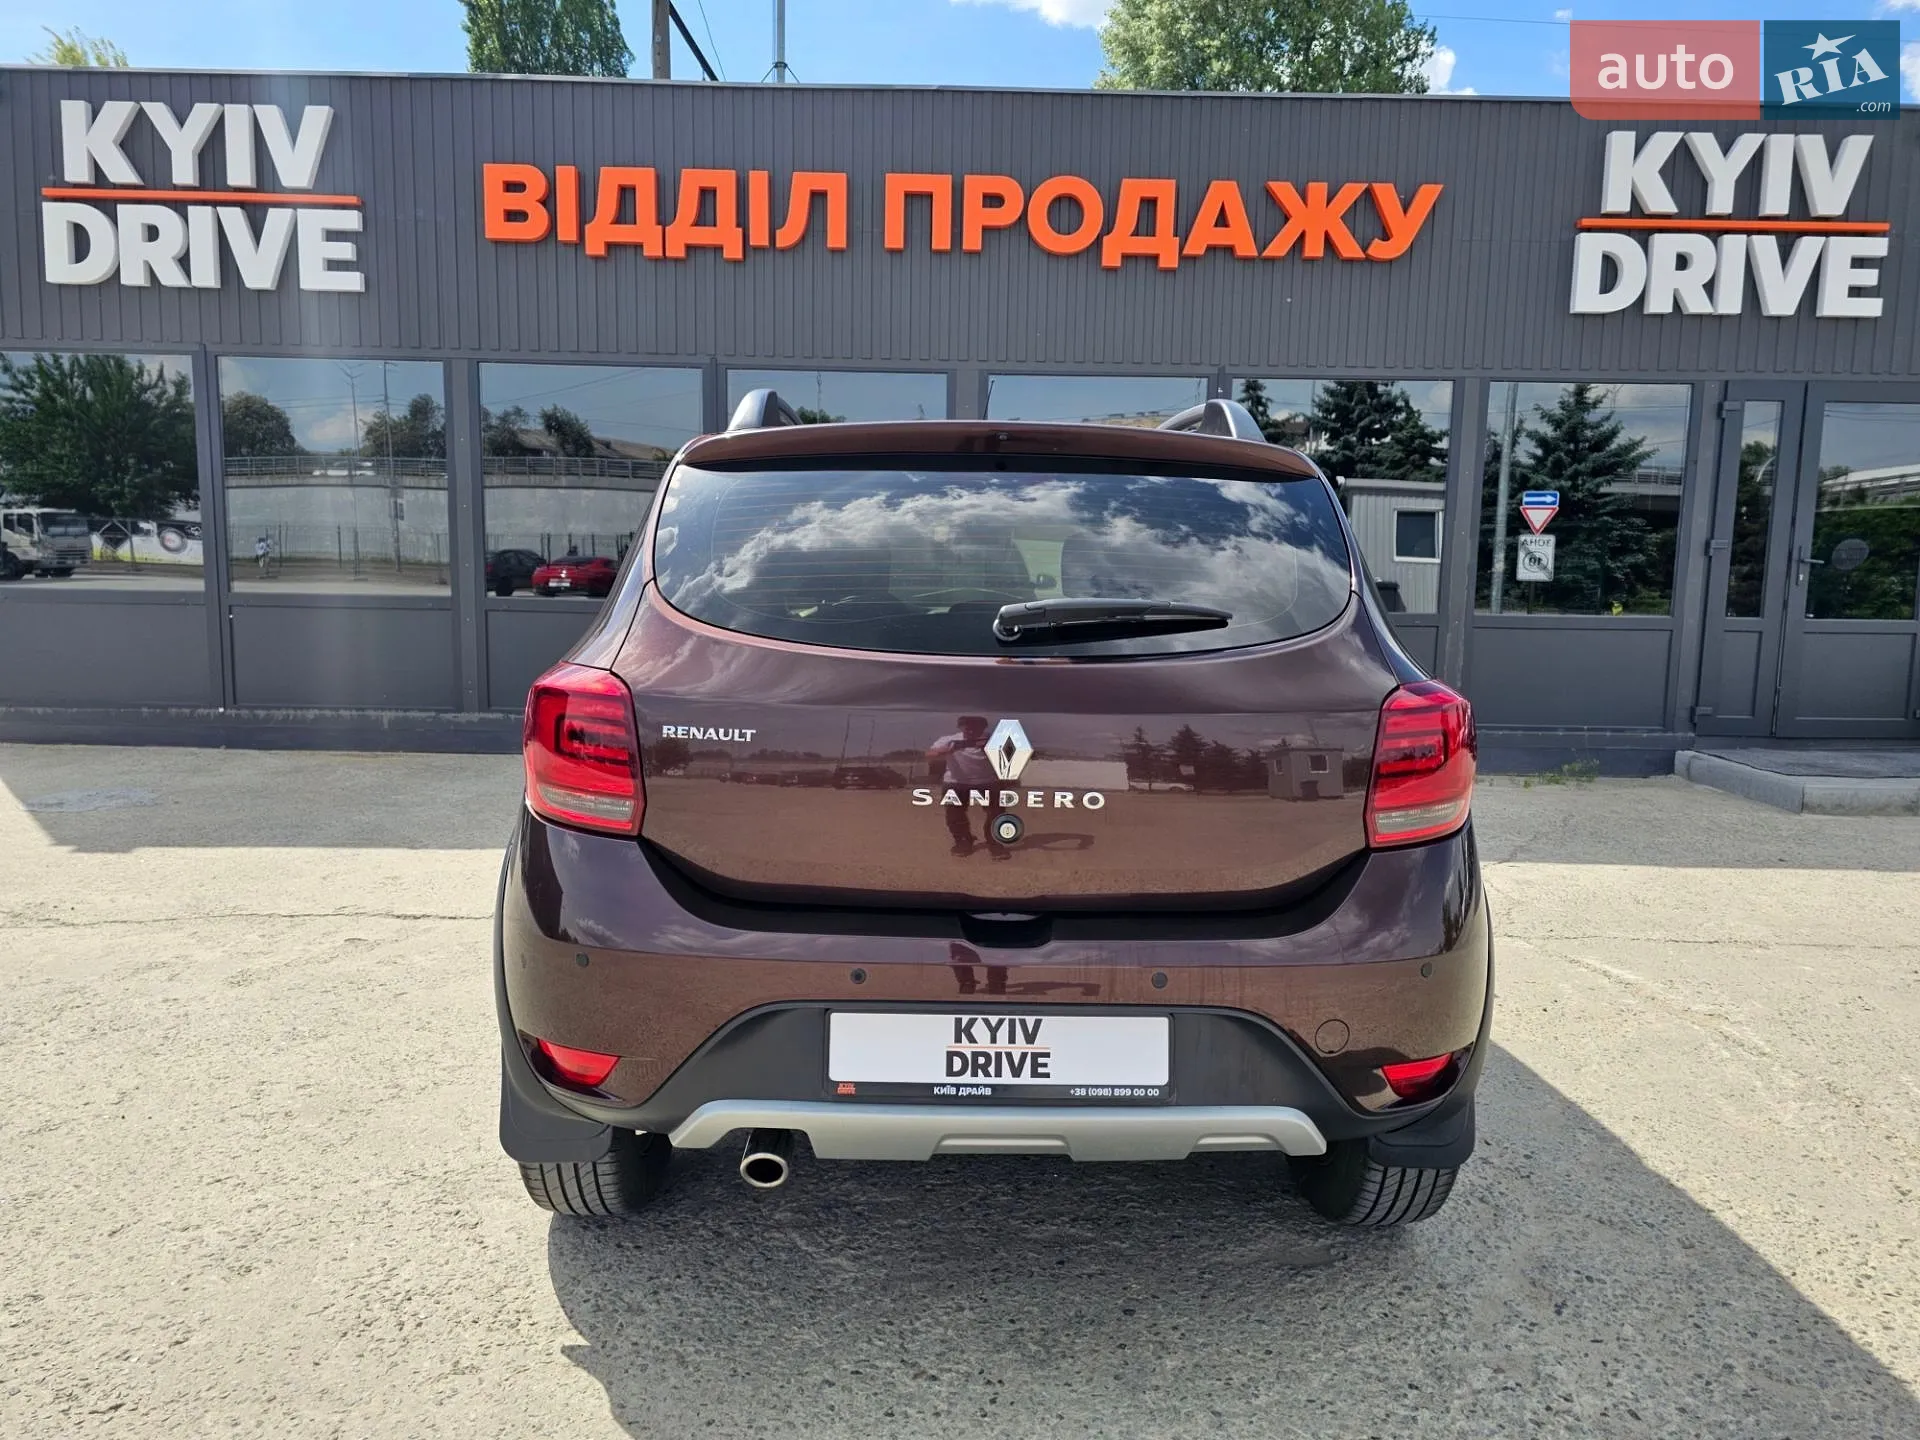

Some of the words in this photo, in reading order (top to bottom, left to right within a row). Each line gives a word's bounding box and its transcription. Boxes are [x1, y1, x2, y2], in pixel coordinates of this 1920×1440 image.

[60, 100, 334, 190] KYIV
[1600, 130, 1874, 217] KYIV
[483, 163, 848, 261] ВІДДІЛ
[884, 172, 1444, 271] ПРОДАЖУ
[42, 202, 365, 293] DRIVE
[1570, 232, 1889, 318] DRIVE
[662, 725, 757, 742] RENAULT
[912, 788, 1105, 809] SANDERO
[954, 1017, 1043, 1045] KYIV
[946, 1050, 1051, 1079] DRIVE
[933, 1085, 957, 1095] КИЇВ
[958, 1085, 992, 1097] ДРАЙВ
[1070, 1088, 1086, 1096] +38
[1133, 1088, 1146, 1096] 00
[1147, 1088, 1160, 1097] 00
